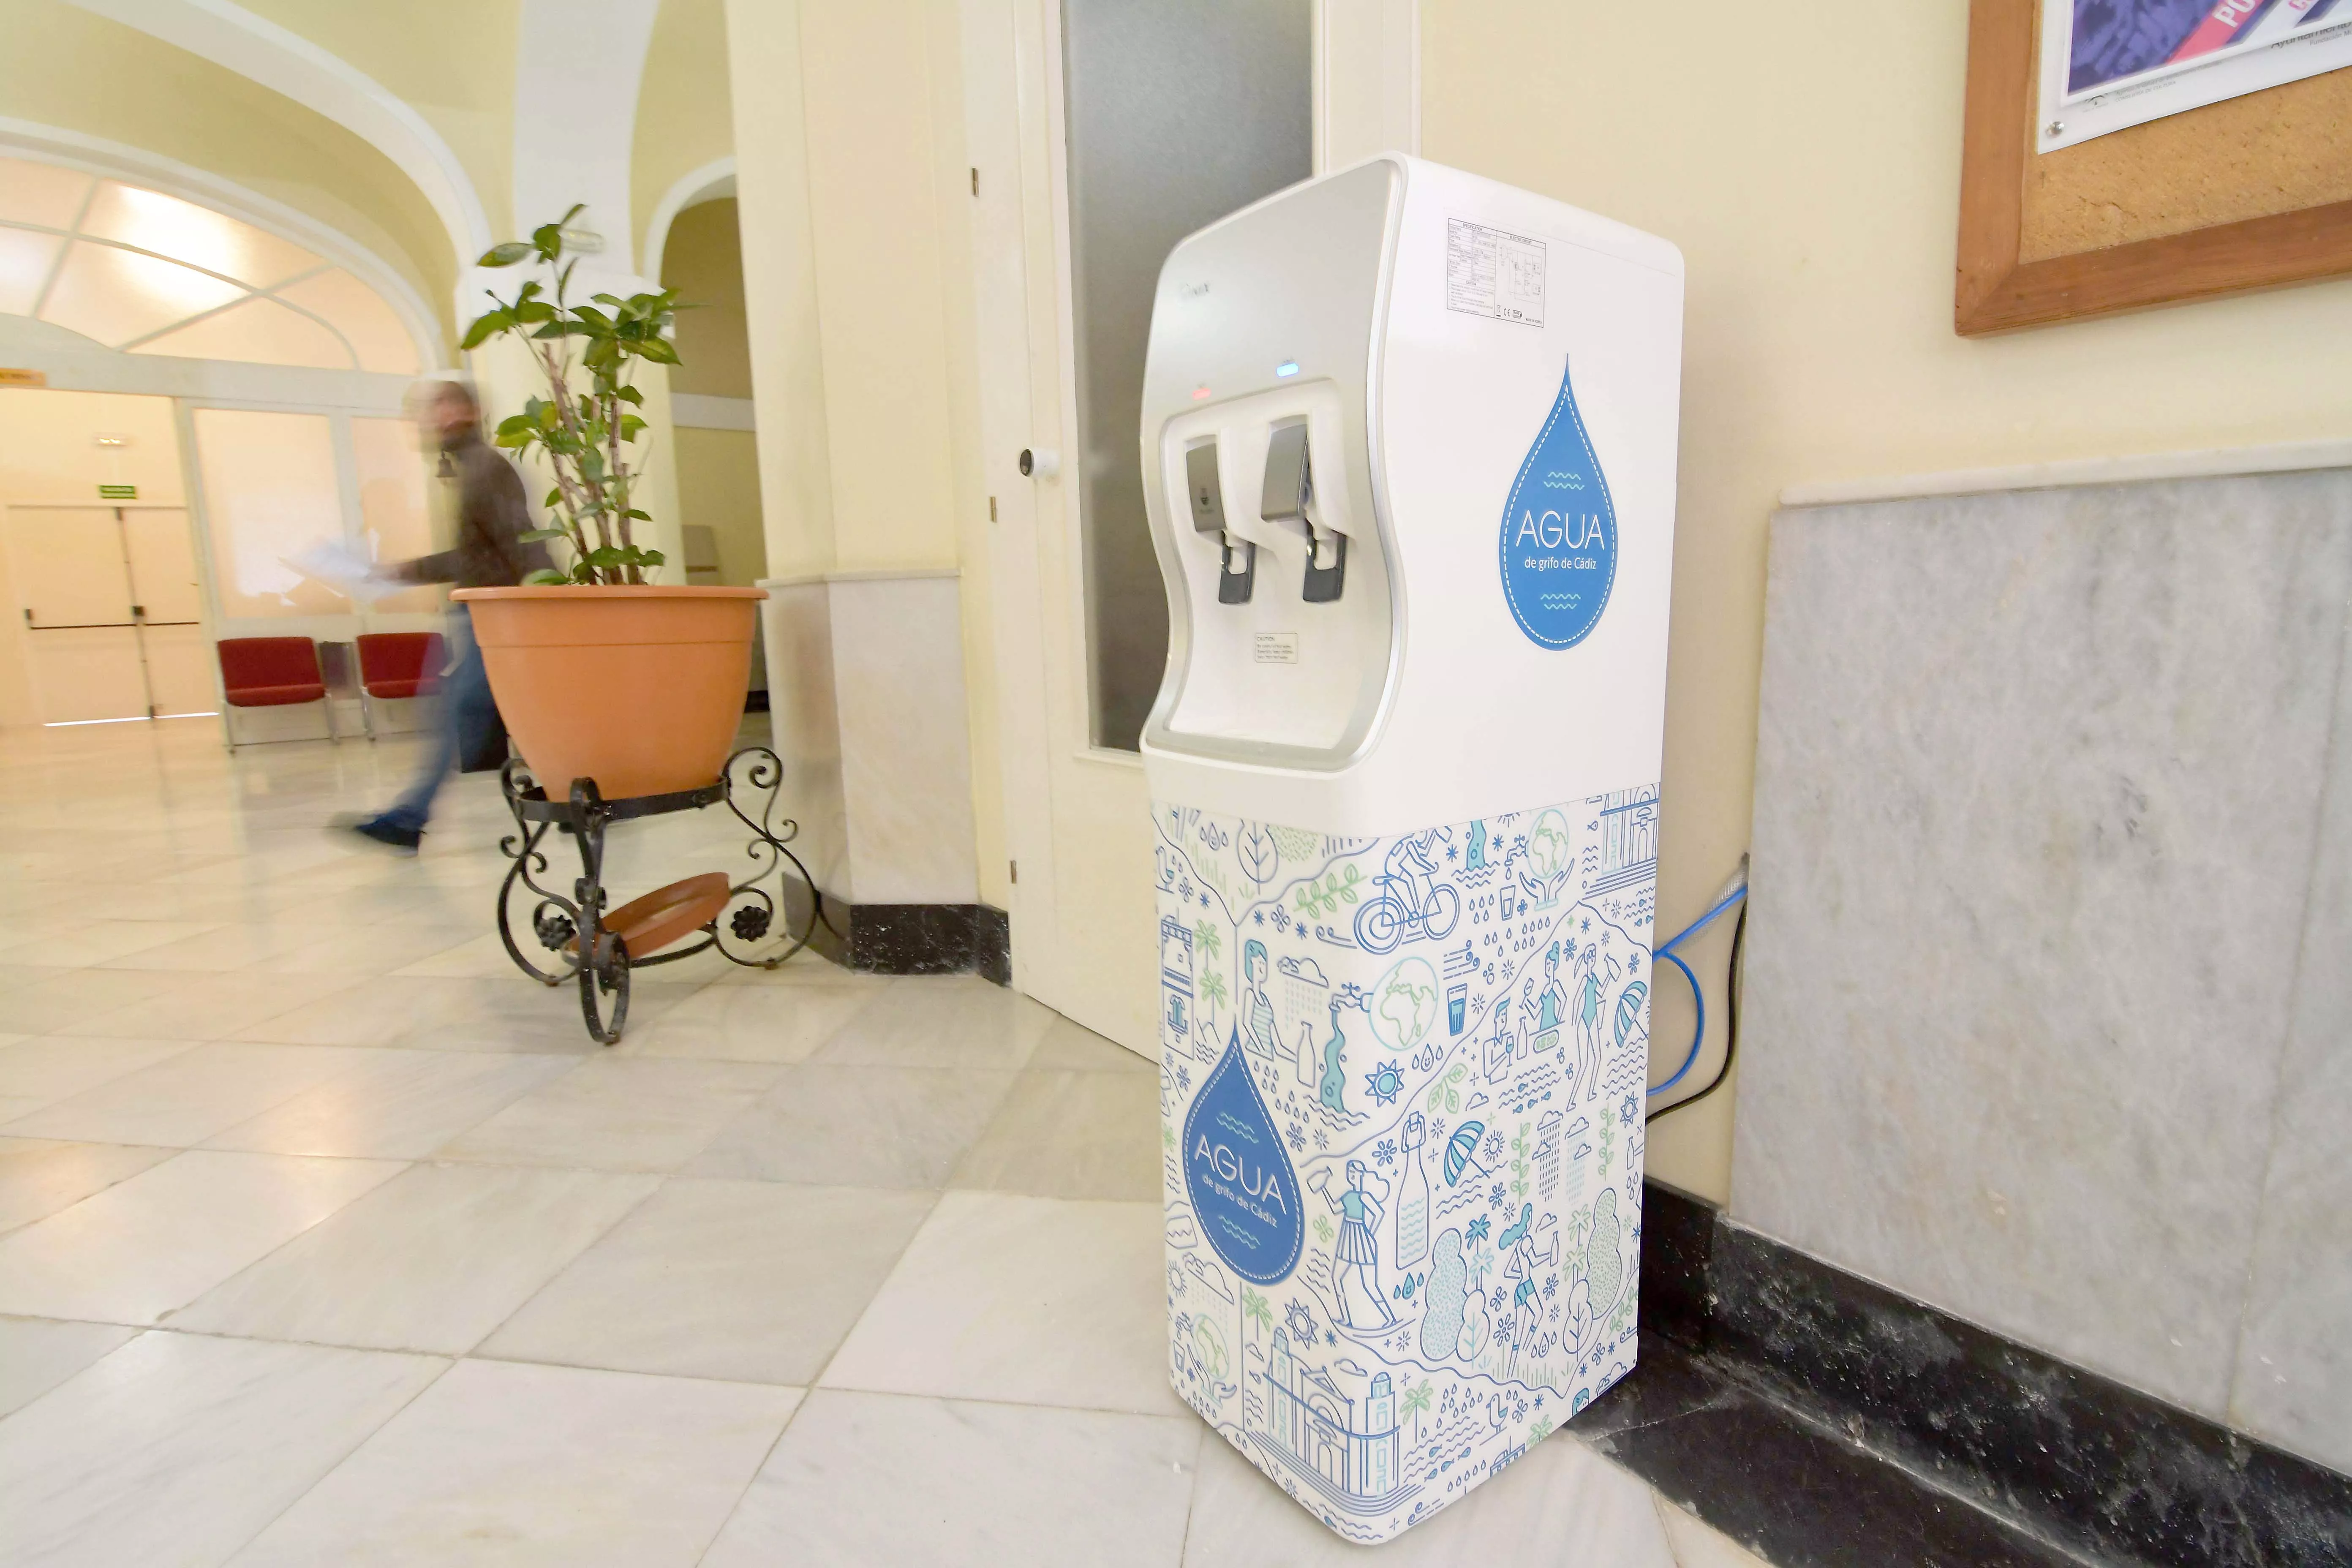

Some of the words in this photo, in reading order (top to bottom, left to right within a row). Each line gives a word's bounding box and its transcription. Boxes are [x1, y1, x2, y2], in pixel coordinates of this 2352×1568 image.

[1516, 509, 1605, 550] AGUA
[1524, 556, 1536, 569] de
[1538, 556, 1559, 571] grifo
[1561, 557, 1572, 569] de
[1574, 557, 1597, 569] Cádiz
[1194, 1132, 1287, 1215] AGUA
[1202, 1173, 1214, 1188] de
[1214, 1181, 1235, 1201] grifo
[1236, 1195, 1249, 1211] de
[1250, 1201, 1278, 1228] Cádiz
